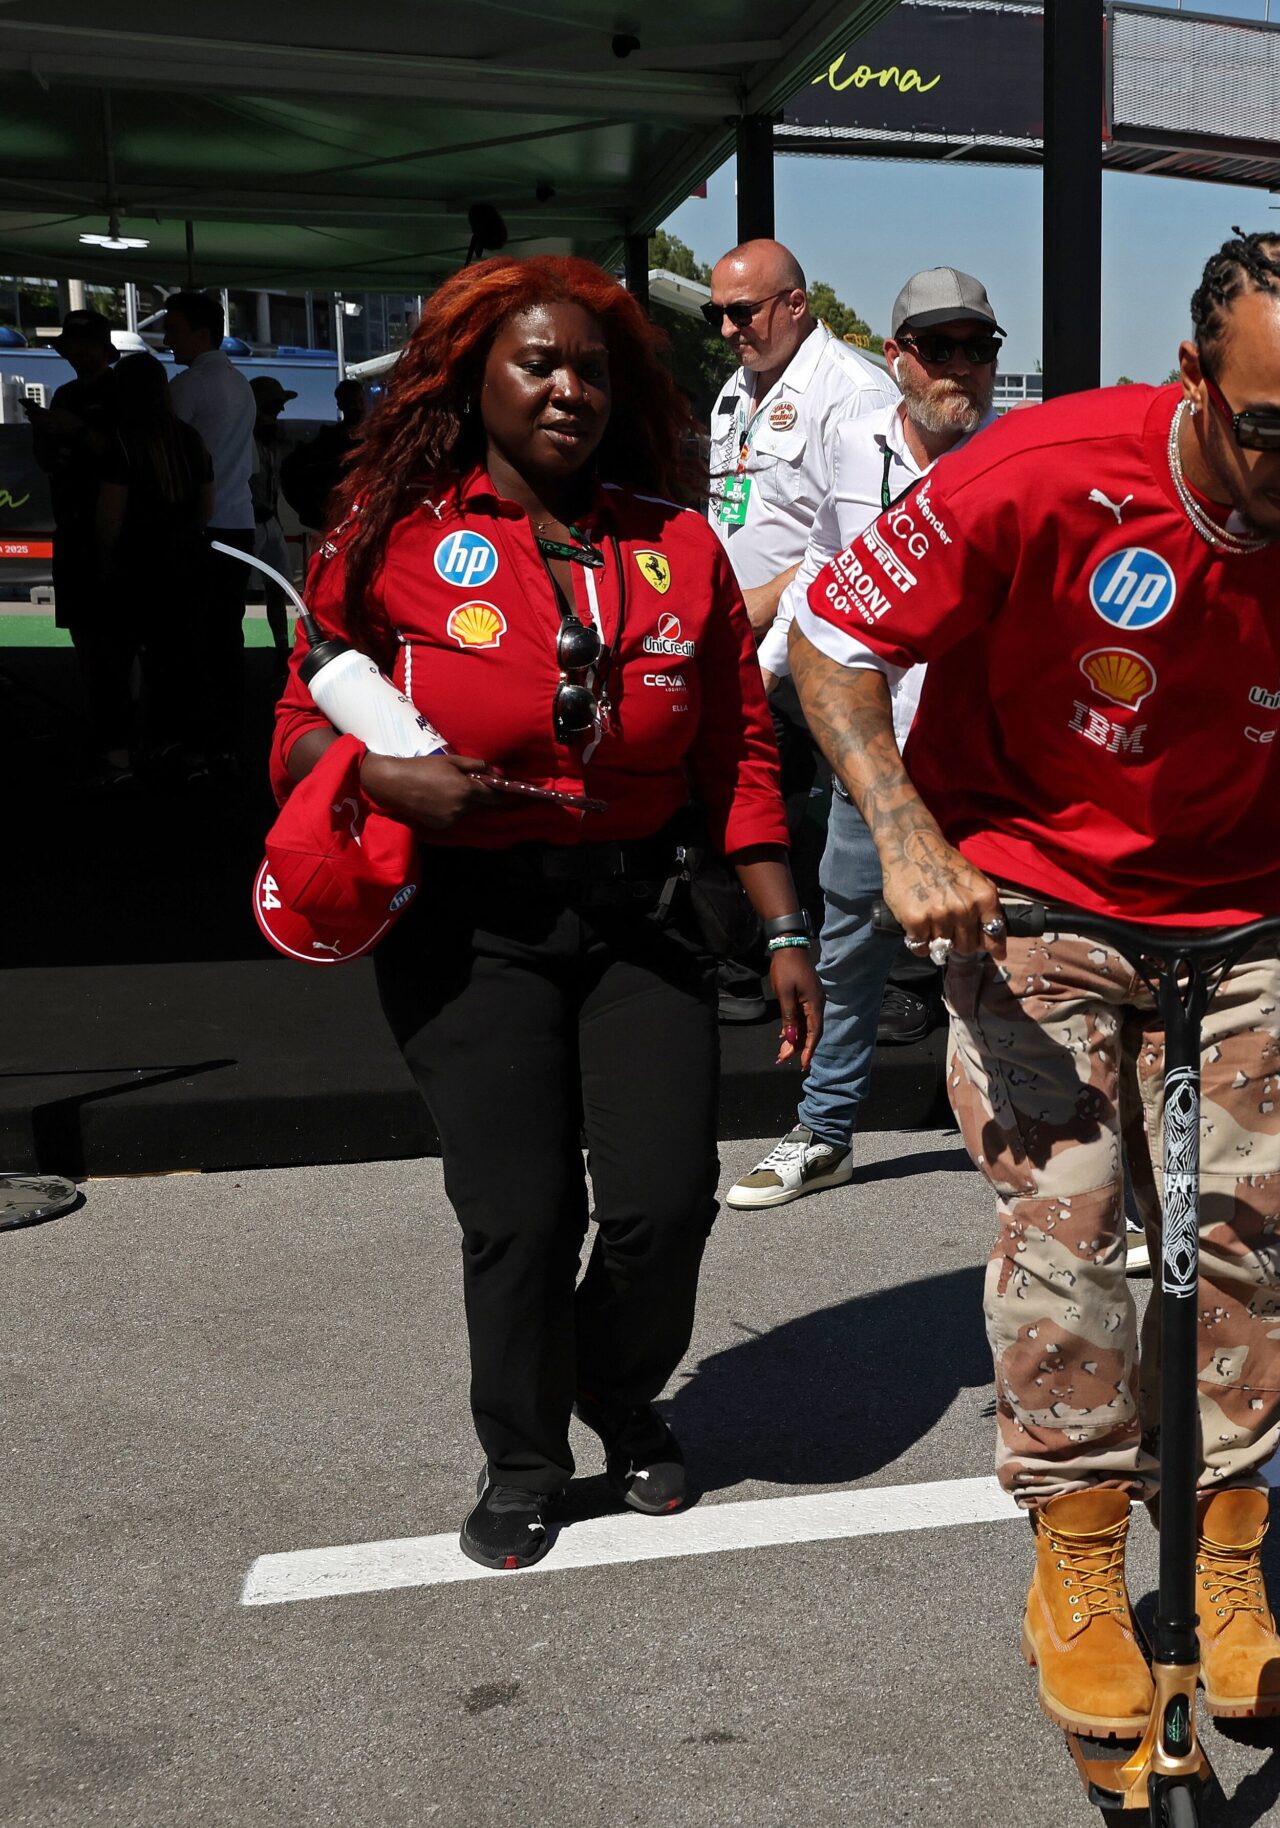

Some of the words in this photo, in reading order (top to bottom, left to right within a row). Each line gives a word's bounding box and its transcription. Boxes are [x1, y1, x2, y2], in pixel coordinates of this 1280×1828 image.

[811, 52, 941, 92] lona
[444, 531, 490, 585] hp
[836, 548, 892, 619] ERONI
[825, 582, 852, 614] 0.0%
[829, 558, 845, 584] STRO
[842, 584, 874, 625] AZZURRO
[1099, 549, 1168, 626] hp
[643, 636, 695, 657] UniCredit
[1068, 699, 1148, 754] IBM
[262, 874, 282, 910] 44
